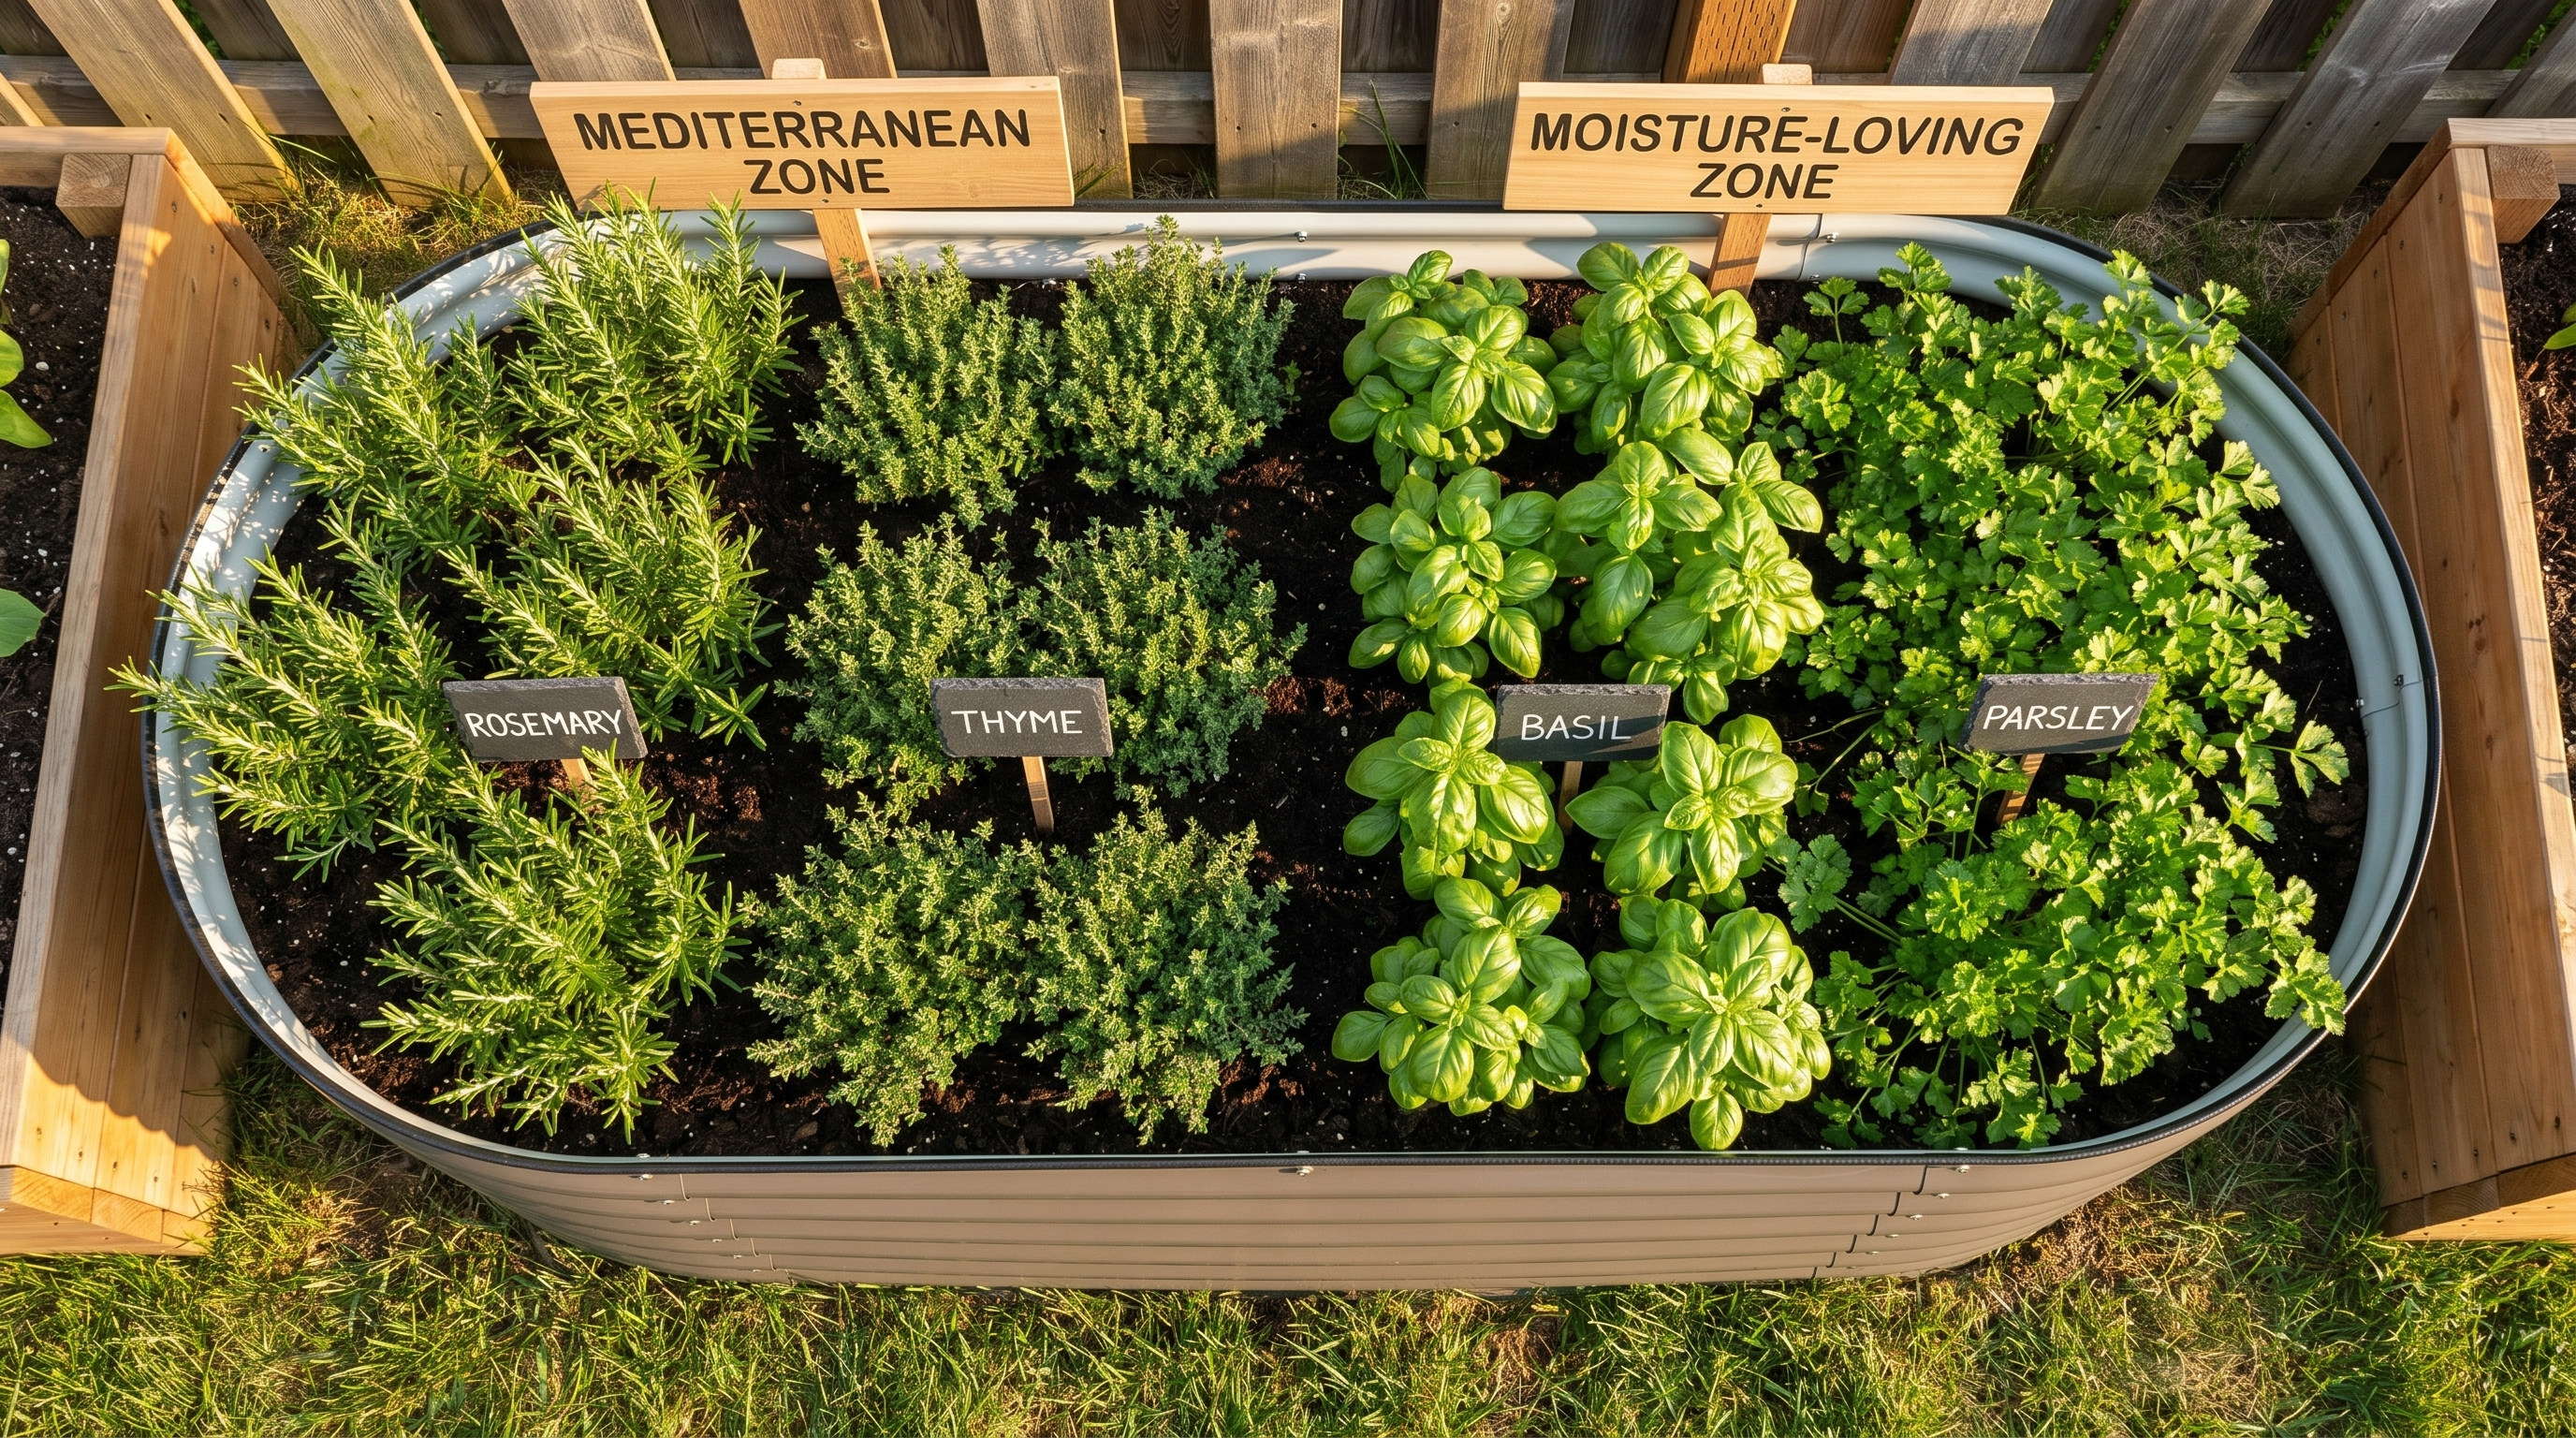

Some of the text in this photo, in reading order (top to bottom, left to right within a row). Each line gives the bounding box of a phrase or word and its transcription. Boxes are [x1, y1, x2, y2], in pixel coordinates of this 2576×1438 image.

[573, 109, 1031, 151] MEDITERRANEAN
[1530, 112, 2024, 155] MOISTURE-LOVING
[743, 158, 890, 195] ZONE
[1690, 163, 1839, 199] ZONE
[463, 709, 622, 738] ROSEMARY
[950, 710, 1084, 735] THYME
[1520, 713, 1632, 741] BASIL
[1982, 704, 2136, 731] PARSLEY
